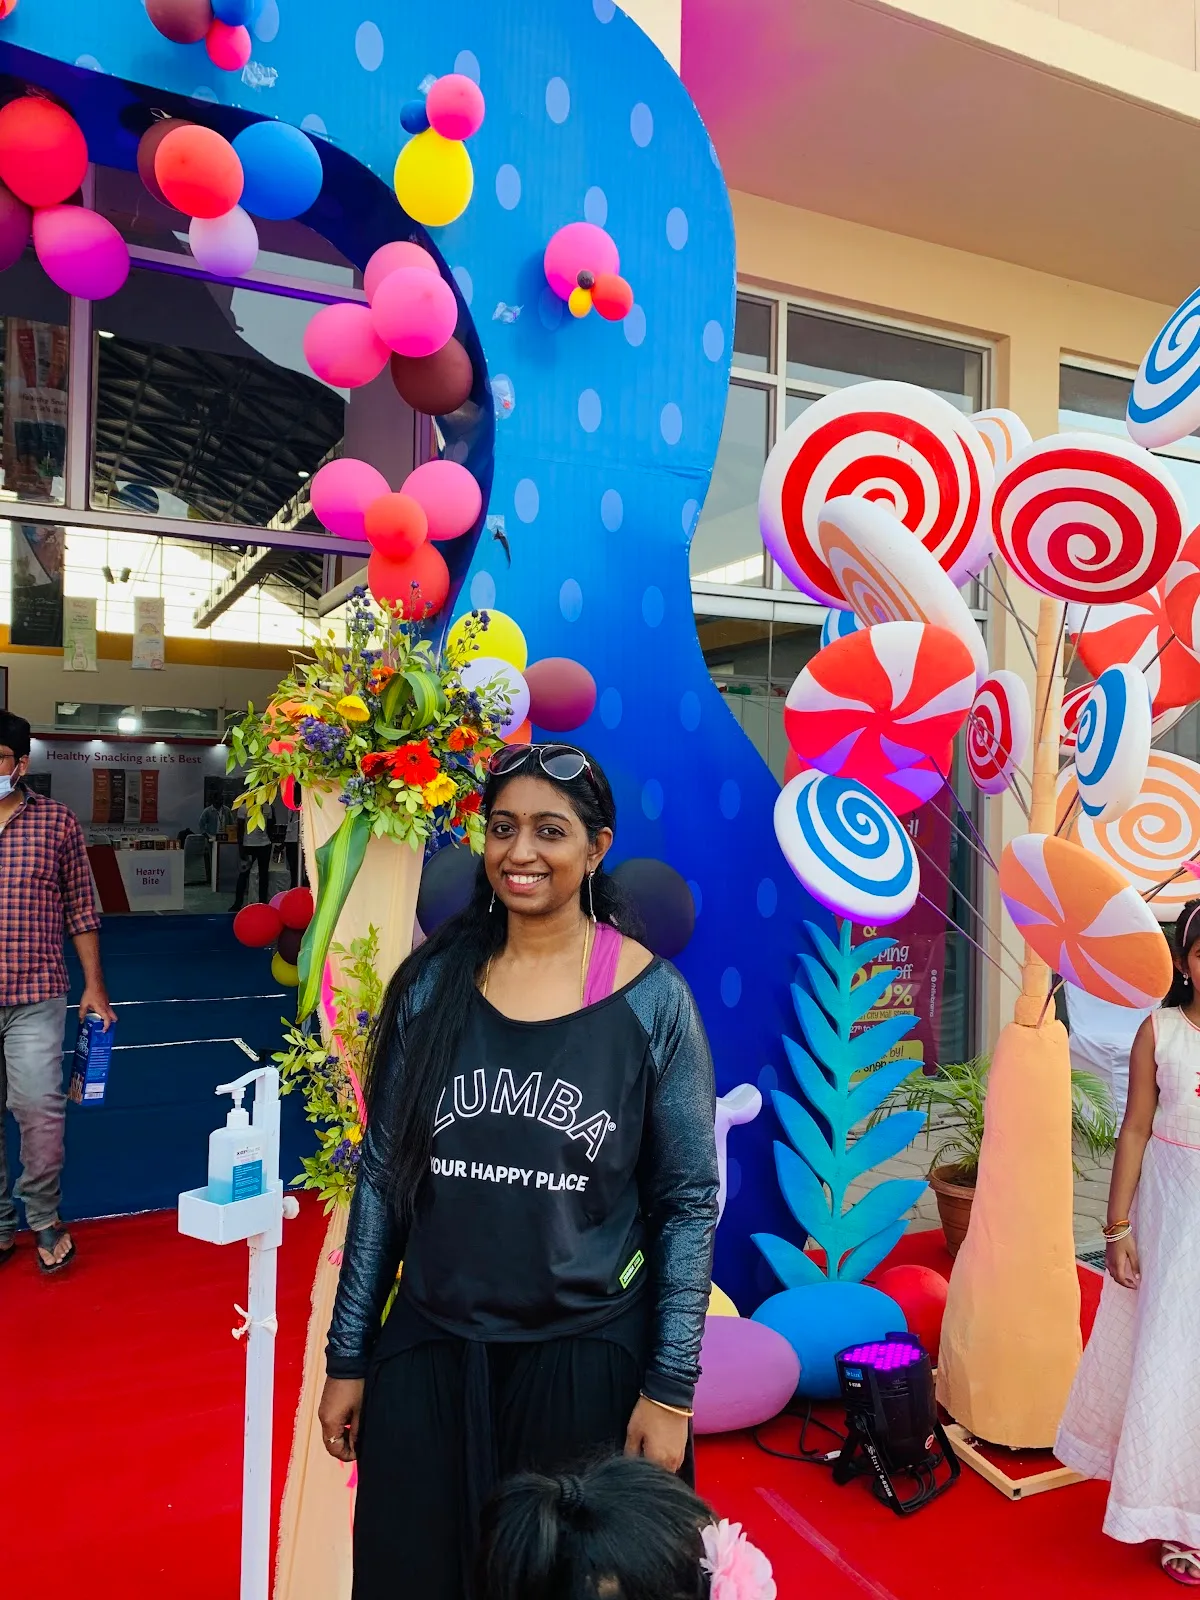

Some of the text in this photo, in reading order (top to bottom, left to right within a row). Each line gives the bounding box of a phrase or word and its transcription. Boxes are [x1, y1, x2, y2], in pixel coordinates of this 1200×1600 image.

[46, 751, 202, 765] Healthy Snacking at it's Best
[136, 868, 165, 877] Hearty
[142, 877, 160, 885] Bite
[470, 1161, 534, 1187] HAPPY
[536, 1170, 589, 1193] PLACE
